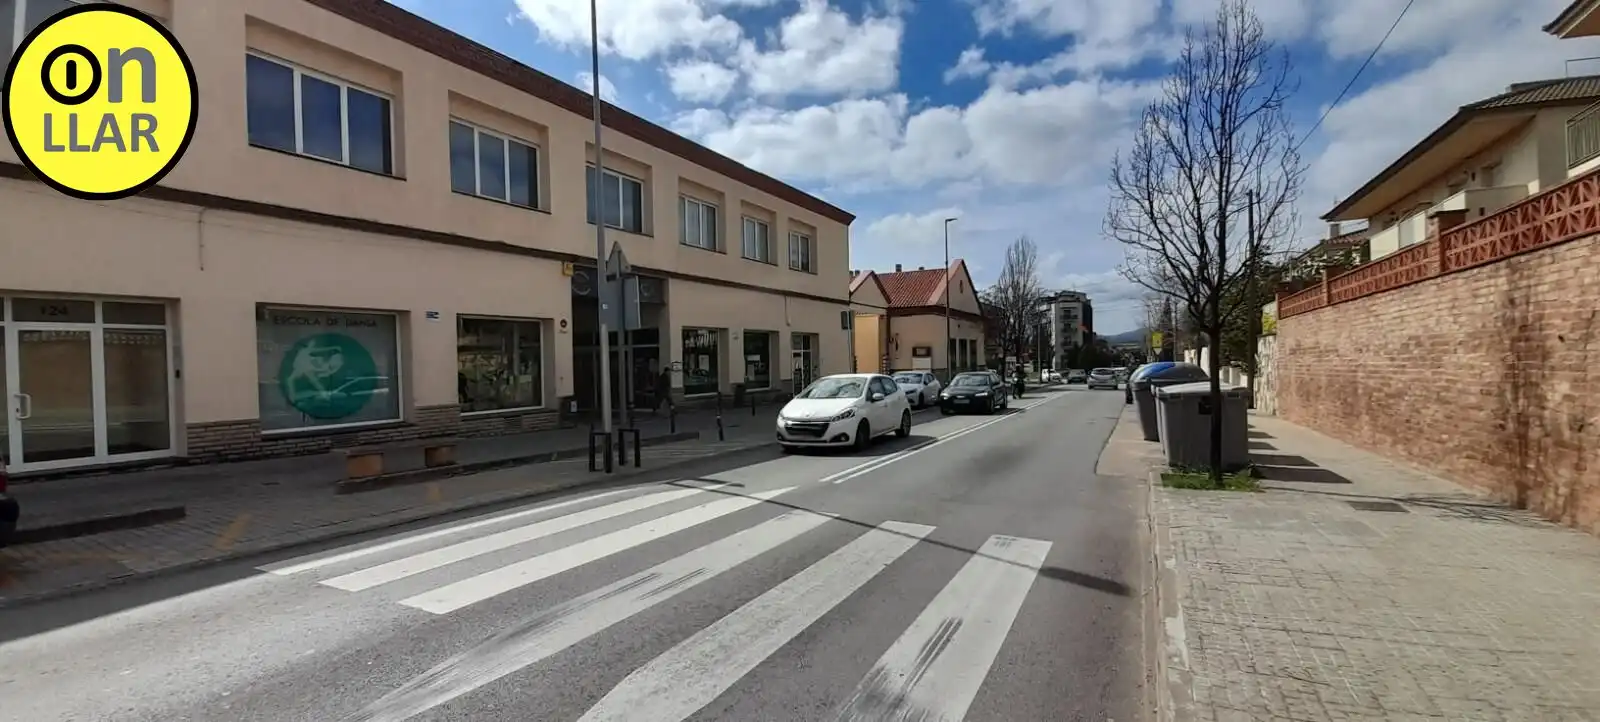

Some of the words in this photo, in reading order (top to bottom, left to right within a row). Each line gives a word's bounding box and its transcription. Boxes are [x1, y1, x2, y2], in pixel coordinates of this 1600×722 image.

[40, 304, 68, 316] 124
[273, 315, 321, 326] ESCOLA
[326, 316, 340, 326] DE
[345, 317, 377, 328] DANSA
